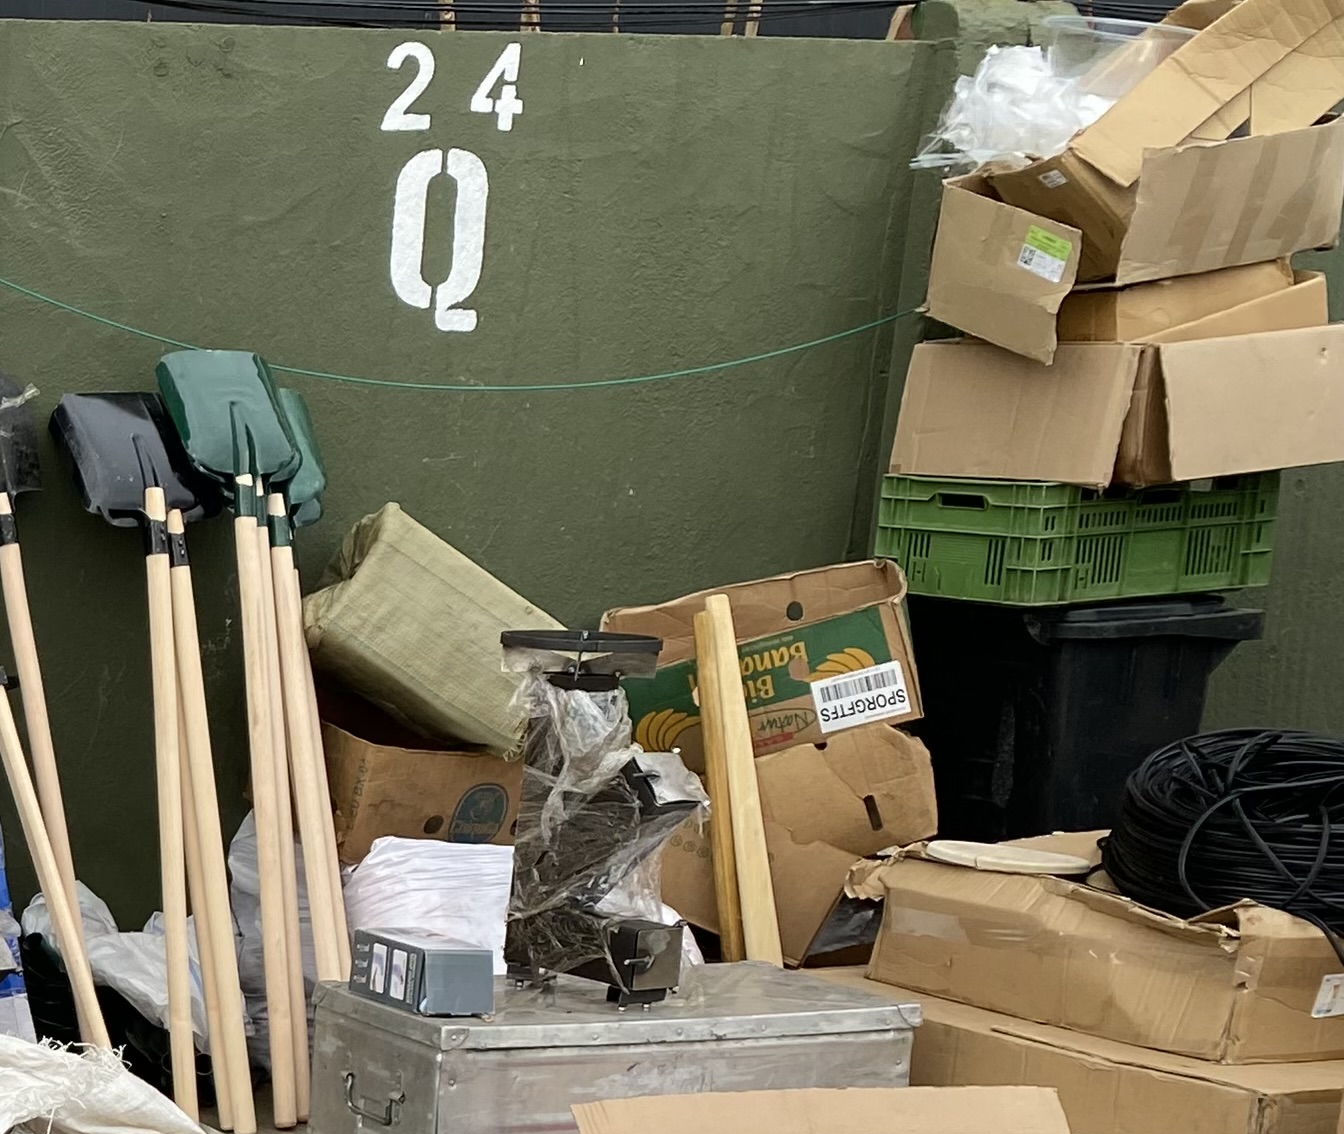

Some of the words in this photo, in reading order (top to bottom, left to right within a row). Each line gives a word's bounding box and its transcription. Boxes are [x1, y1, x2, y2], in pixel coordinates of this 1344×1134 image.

[381, 42, 523, 131] 24
[390, 148, 489, 332] Q
[820, 689, 906, 722] SPORGFTFS
